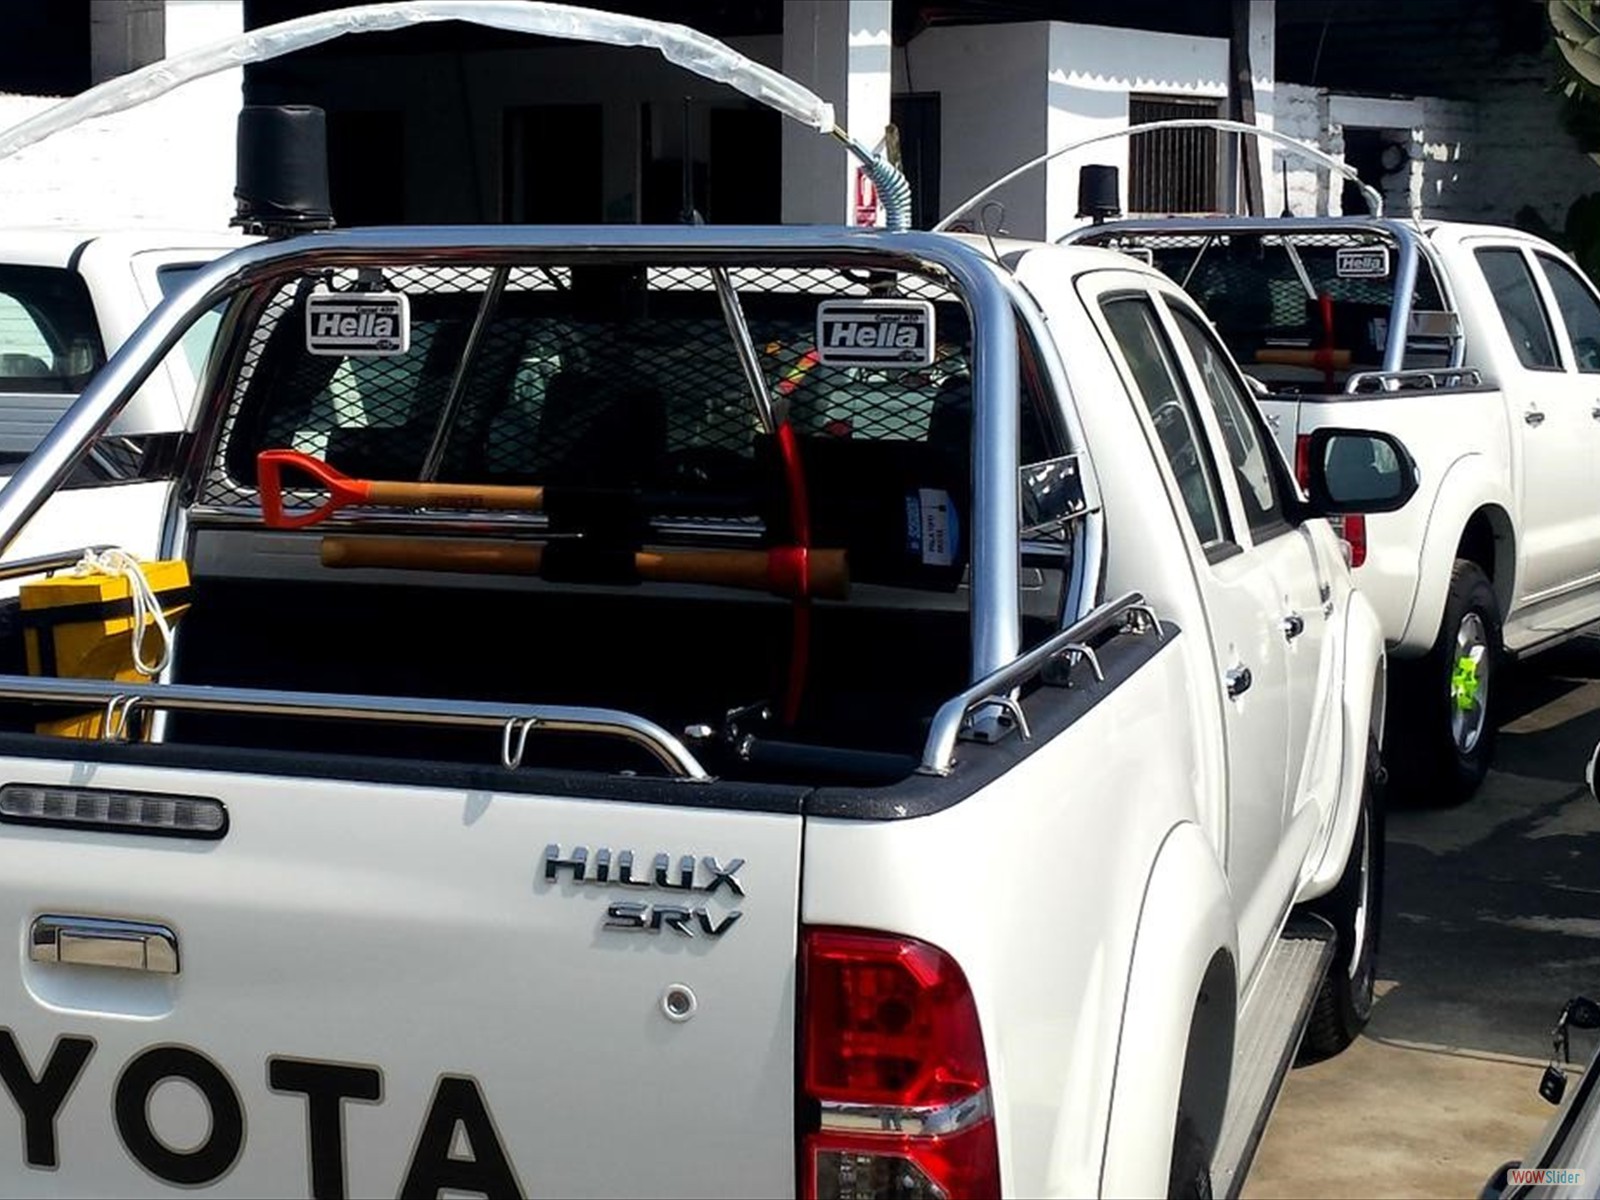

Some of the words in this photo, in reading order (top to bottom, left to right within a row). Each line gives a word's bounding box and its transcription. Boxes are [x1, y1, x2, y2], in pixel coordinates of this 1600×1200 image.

[1342, 257, 1381, 269] Hella
[317, 313, 394, 337] Hella
[829, 322, 919, 348] Hella
[545, 843, 746, 897] HILUX
[602, 901, 743, 938] SRV
